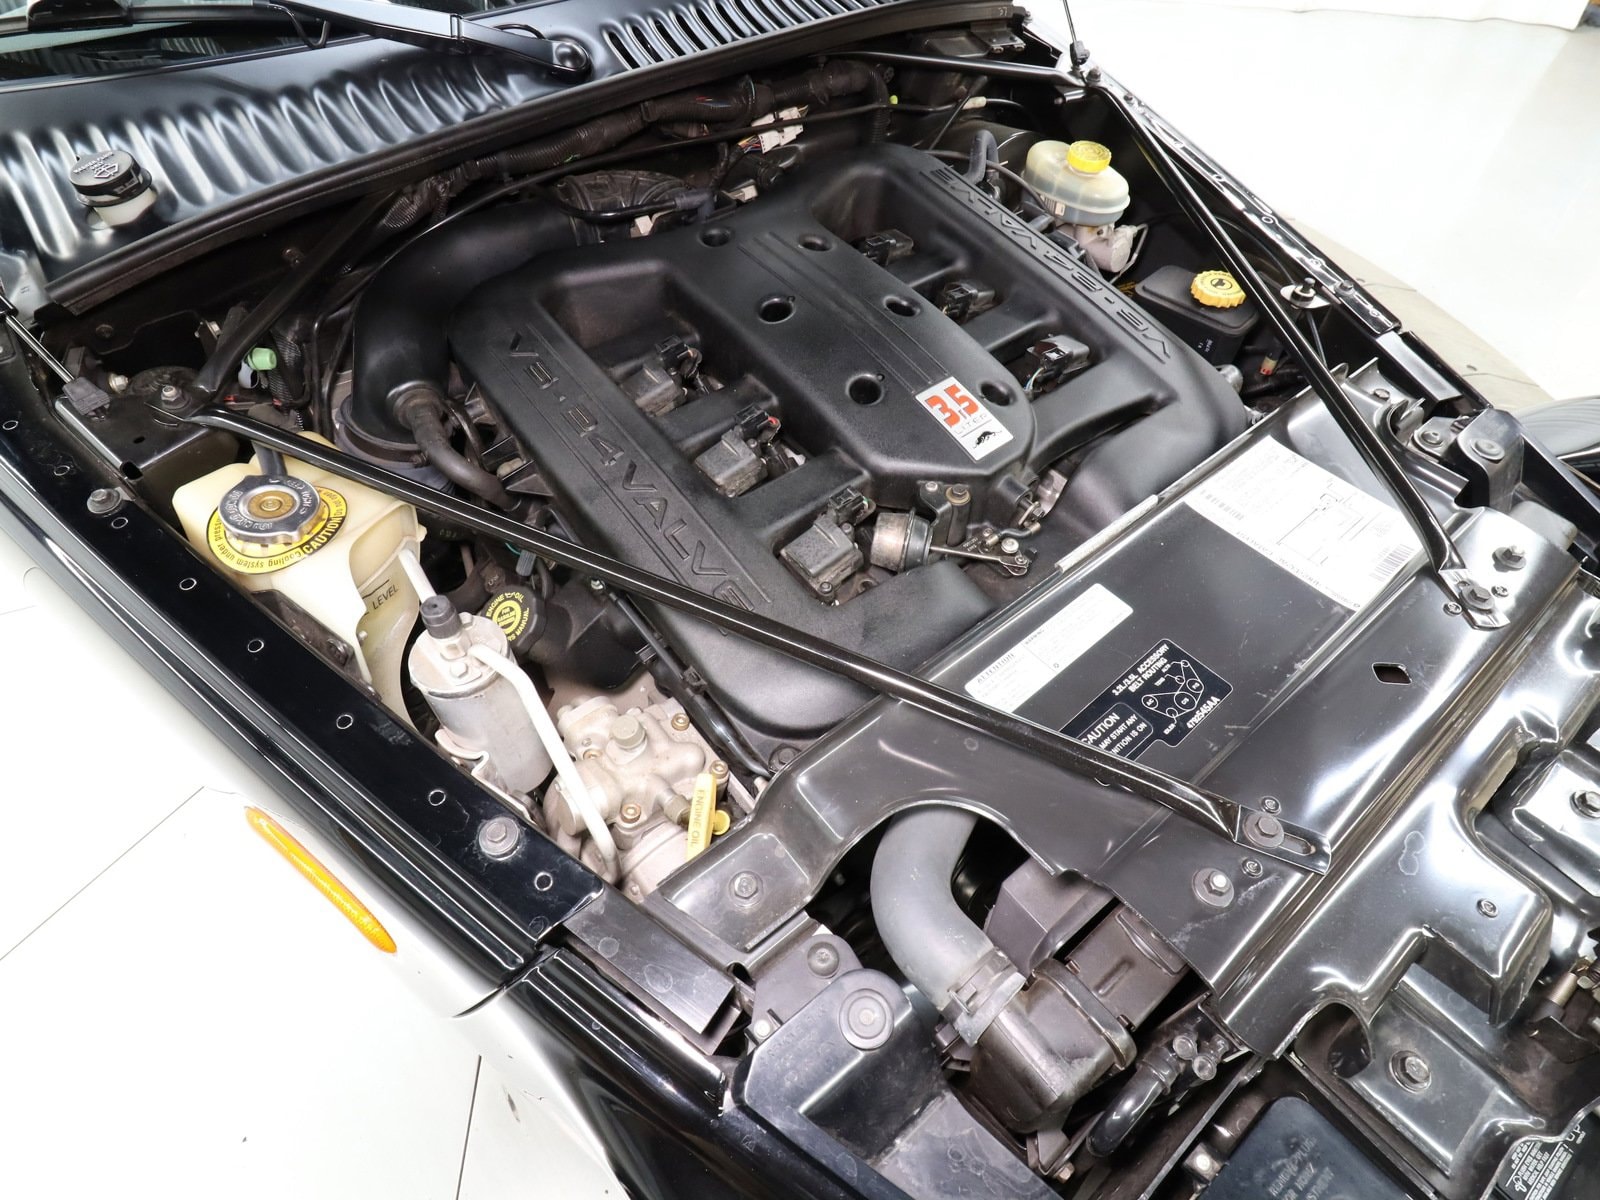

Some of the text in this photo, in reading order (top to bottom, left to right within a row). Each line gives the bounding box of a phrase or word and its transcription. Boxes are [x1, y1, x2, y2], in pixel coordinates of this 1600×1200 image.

[303, 516, 343, 555] CAUTION
[219, 543, 236, 562] under
[237, 559, 265, 569] system
[268, 549, 301, 567] Cooling
[372, 584, 399, 610] LEVEL
[485, 593, 505, 618] ENGINE
[515, 607, 530, 636] MANUAL
[1112, 643, 1169, 696] 3.2L/3.5L ACCESSORY
[1128, 657, 1168, 693] BELT ROUTING
[1082, 711, 1120, 743] CAUTION
[1098, 713, 1138, 749] MAY START ANY
[1110, 721, 1147, 755] NITION IS ON
[692, 789, 705, 828] ENGINE
